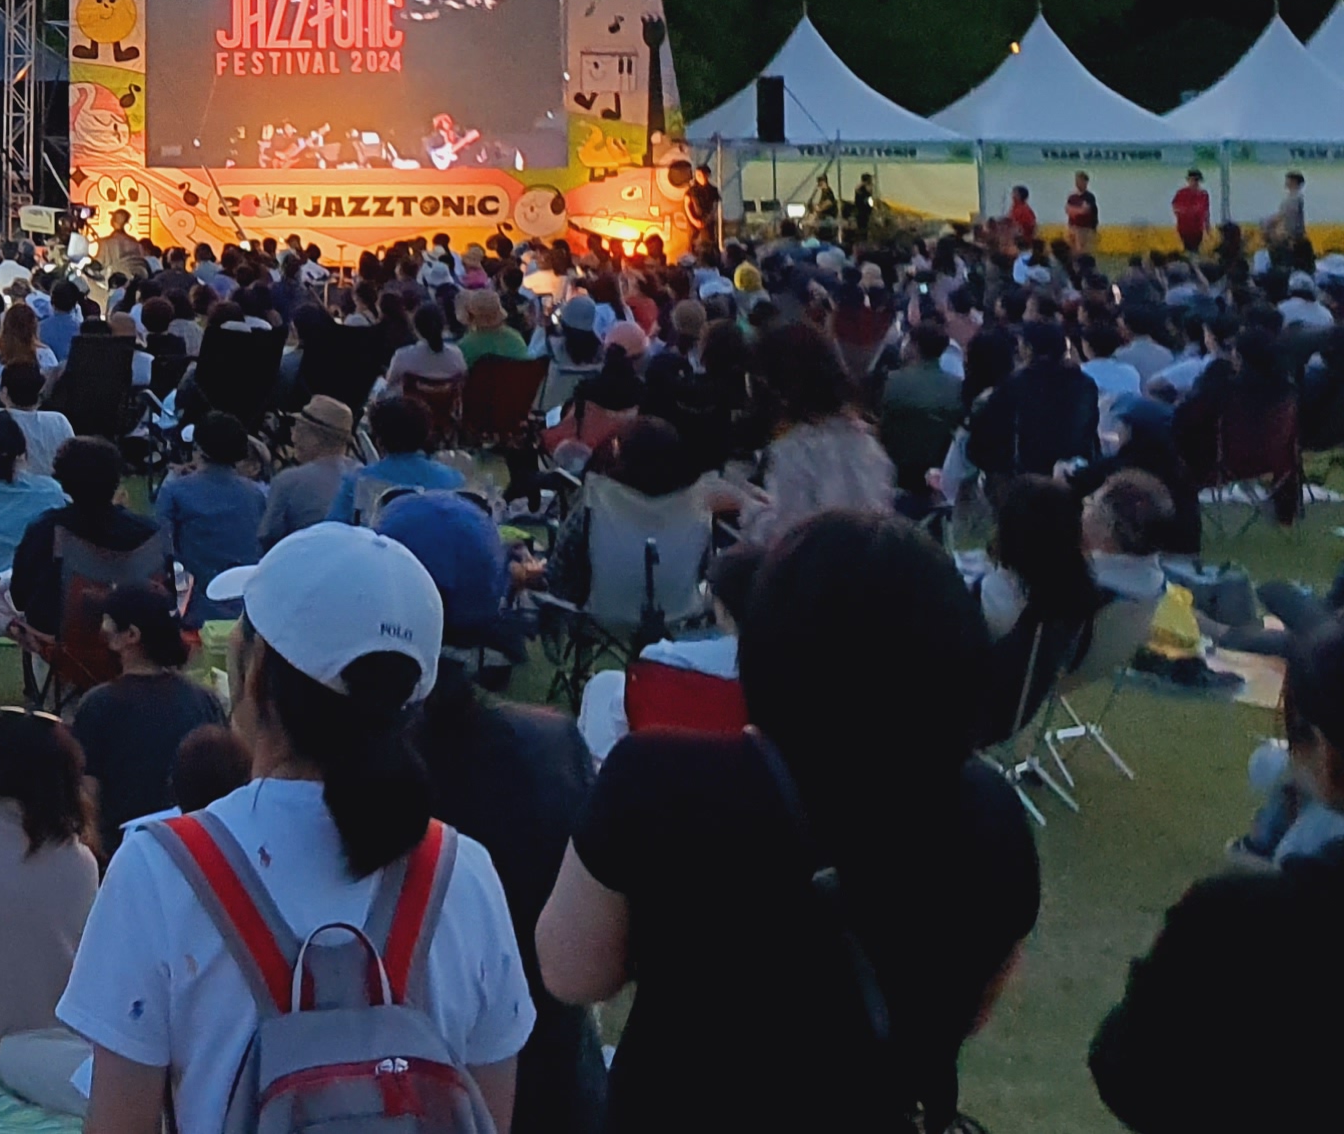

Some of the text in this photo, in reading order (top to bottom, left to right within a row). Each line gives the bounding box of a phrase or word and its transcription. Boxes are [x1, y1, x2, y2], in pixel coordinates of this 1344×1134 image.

[216, 50, 402, 76] FESTIVAL 2024
[303, 195, 501, 217] JAZZTONIC
[380, 622, 413, 642] POLO
